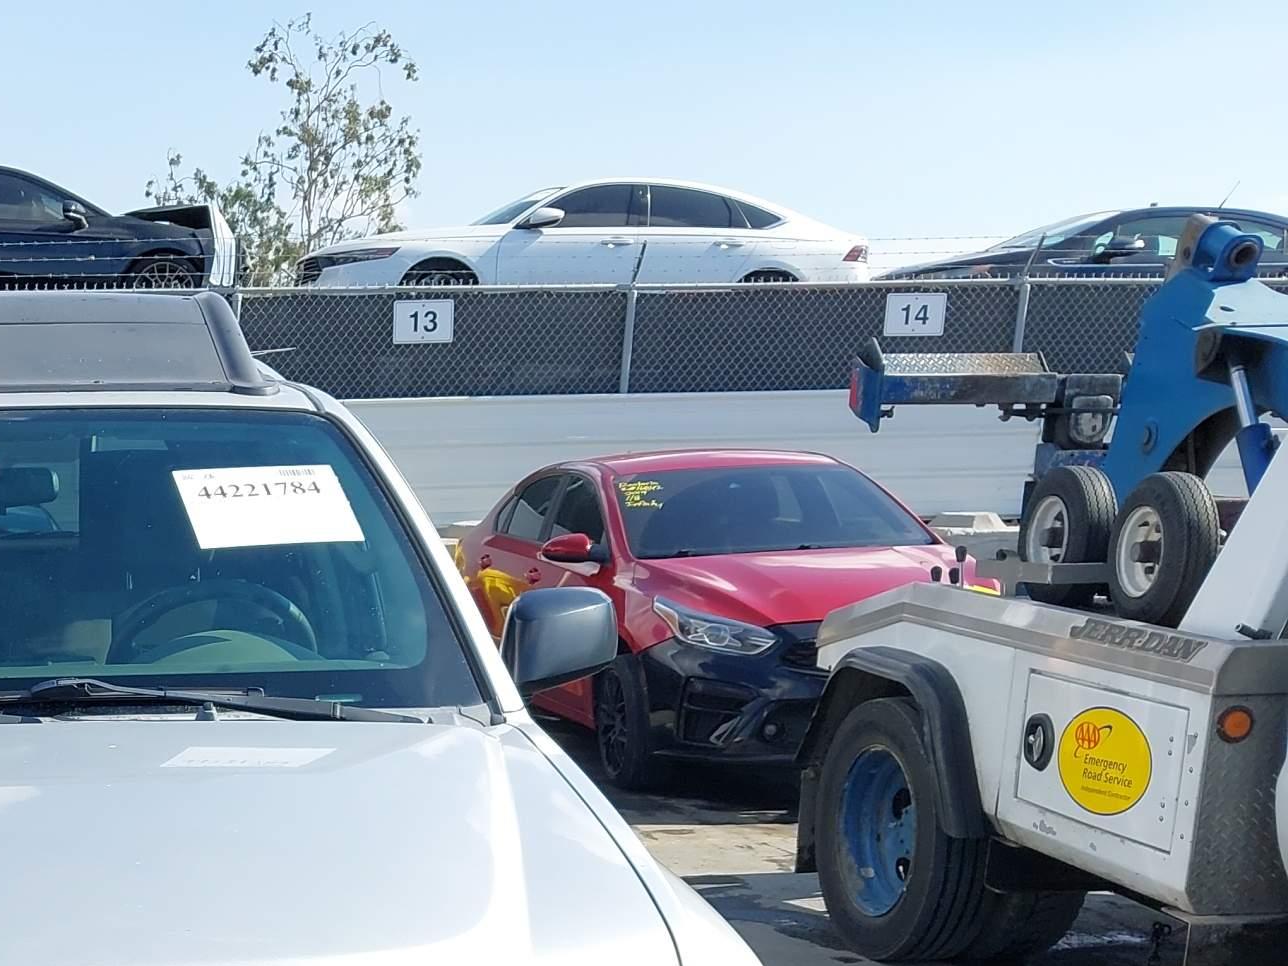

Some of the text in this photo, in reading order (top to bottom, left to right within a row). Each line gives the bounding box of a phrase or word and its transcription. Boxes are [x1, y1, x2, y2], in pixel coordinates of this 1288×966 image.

[409, 310, 438, 333] 13
[901, 303, 929, 326] 14
[197, 481, 321, 499] 44221784
[1084, 753, 1128, 774] Emergency
[1082, 767, 1133, 788] Road Service
